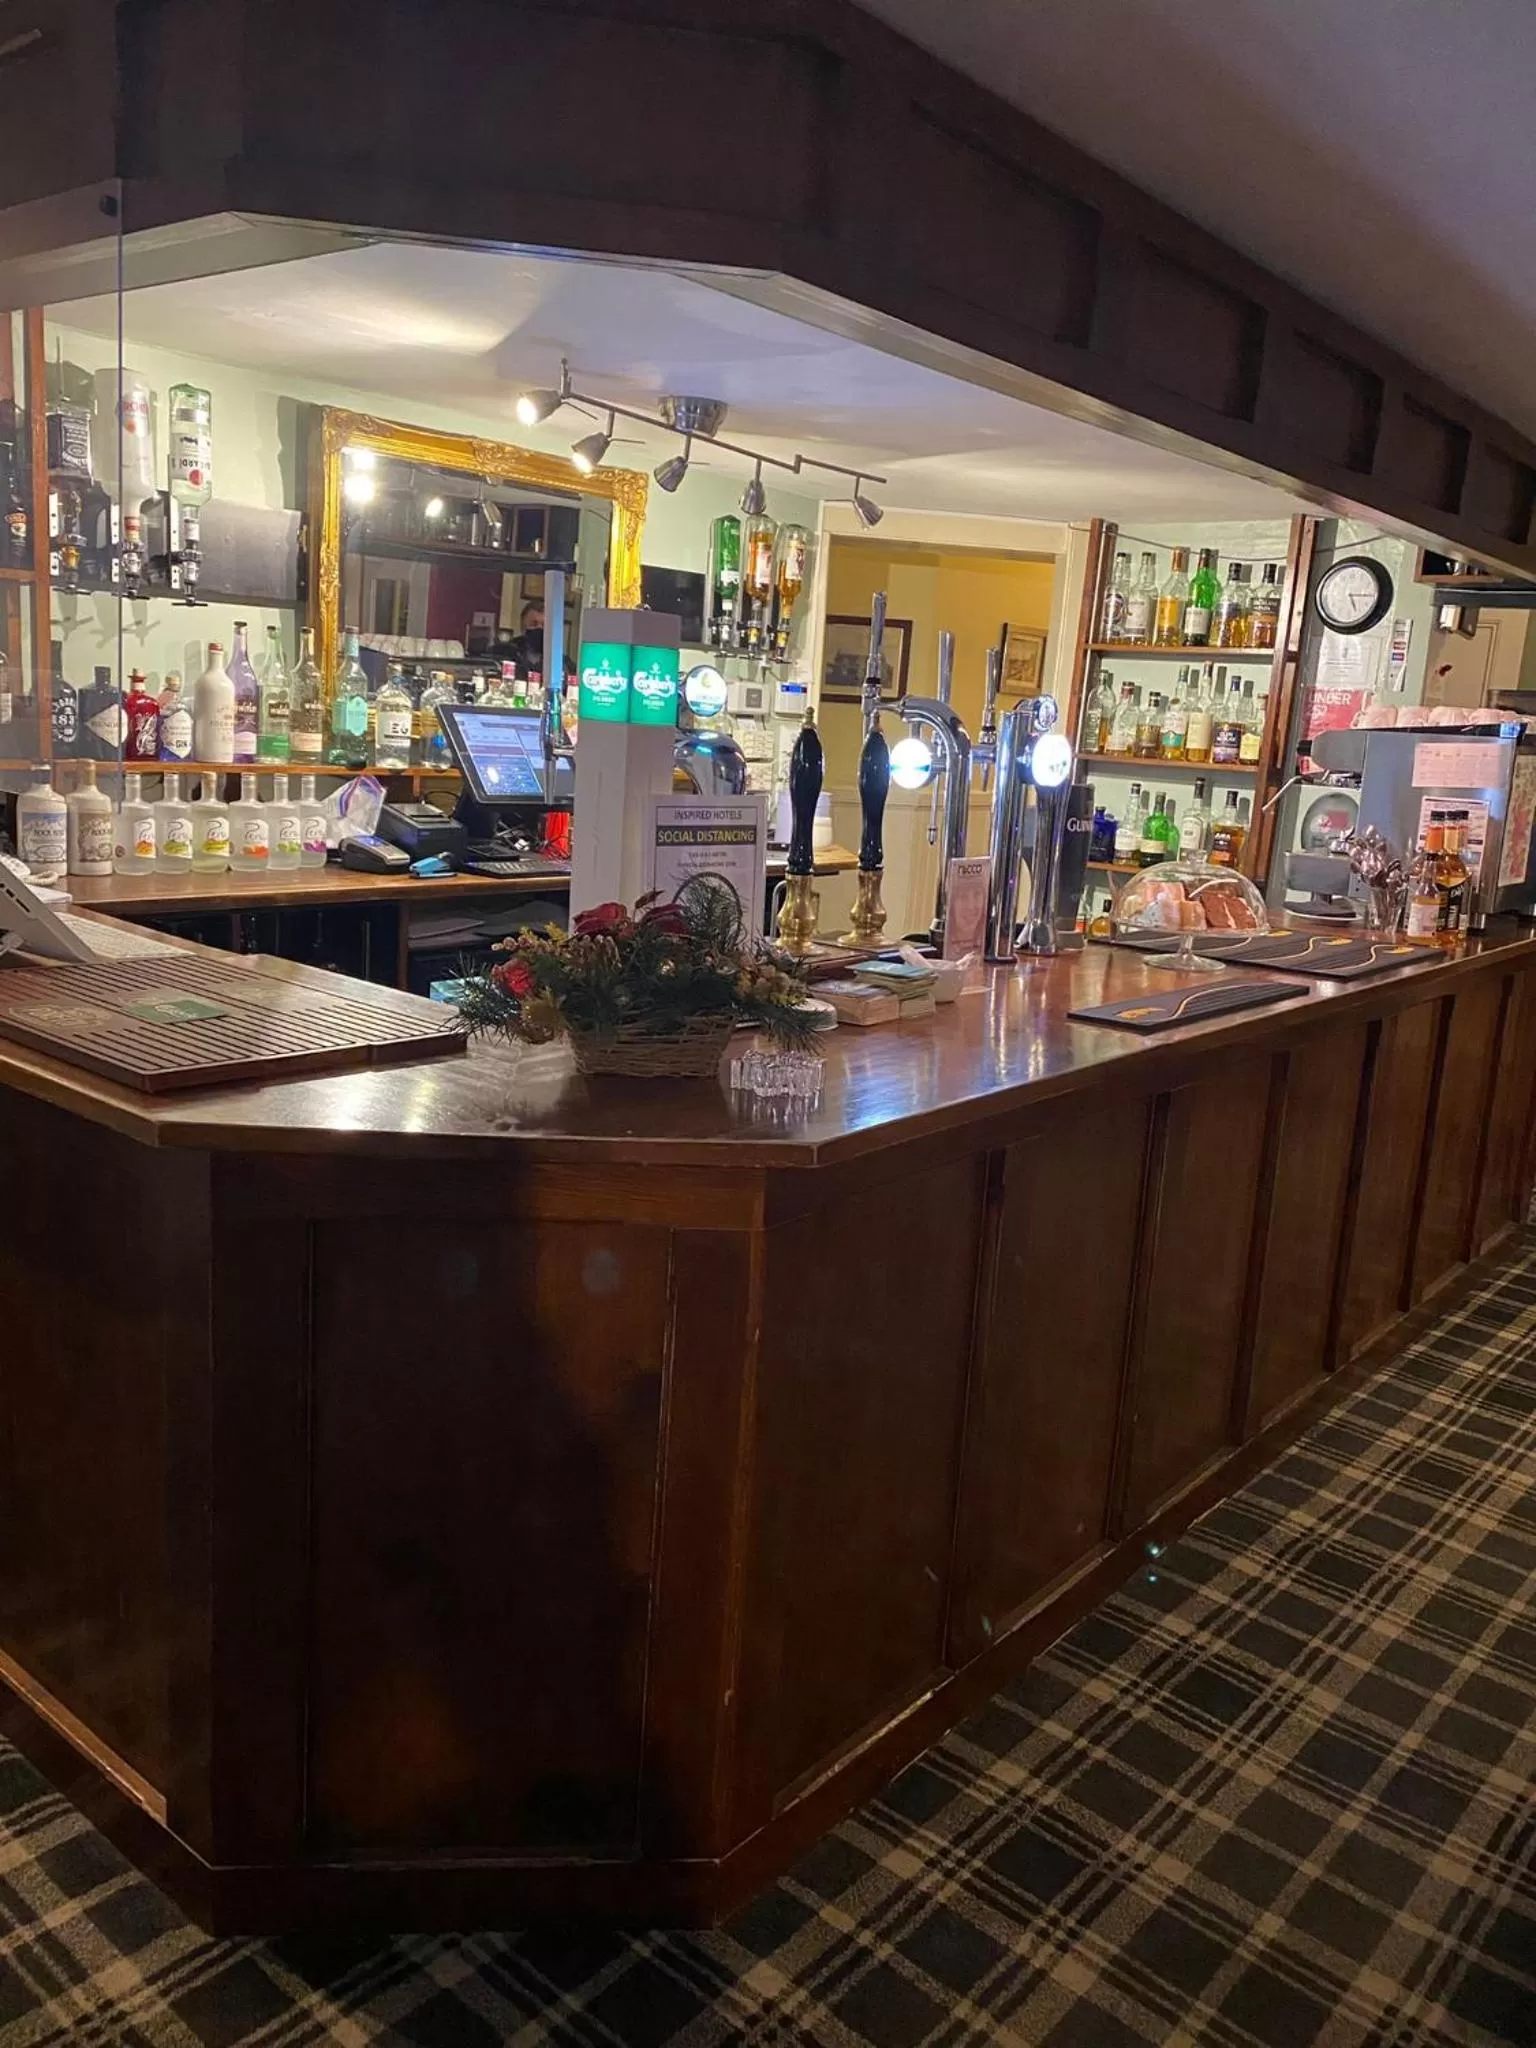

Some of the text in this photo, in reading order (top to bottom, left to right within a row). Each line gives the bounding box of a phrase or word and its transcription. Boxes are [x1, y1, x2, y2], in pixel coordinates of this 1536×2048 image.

[674, 809, 743, 821] INSPIRED HOTELS
[658, 829, 755, 843] SOCIAL DISTANCING
